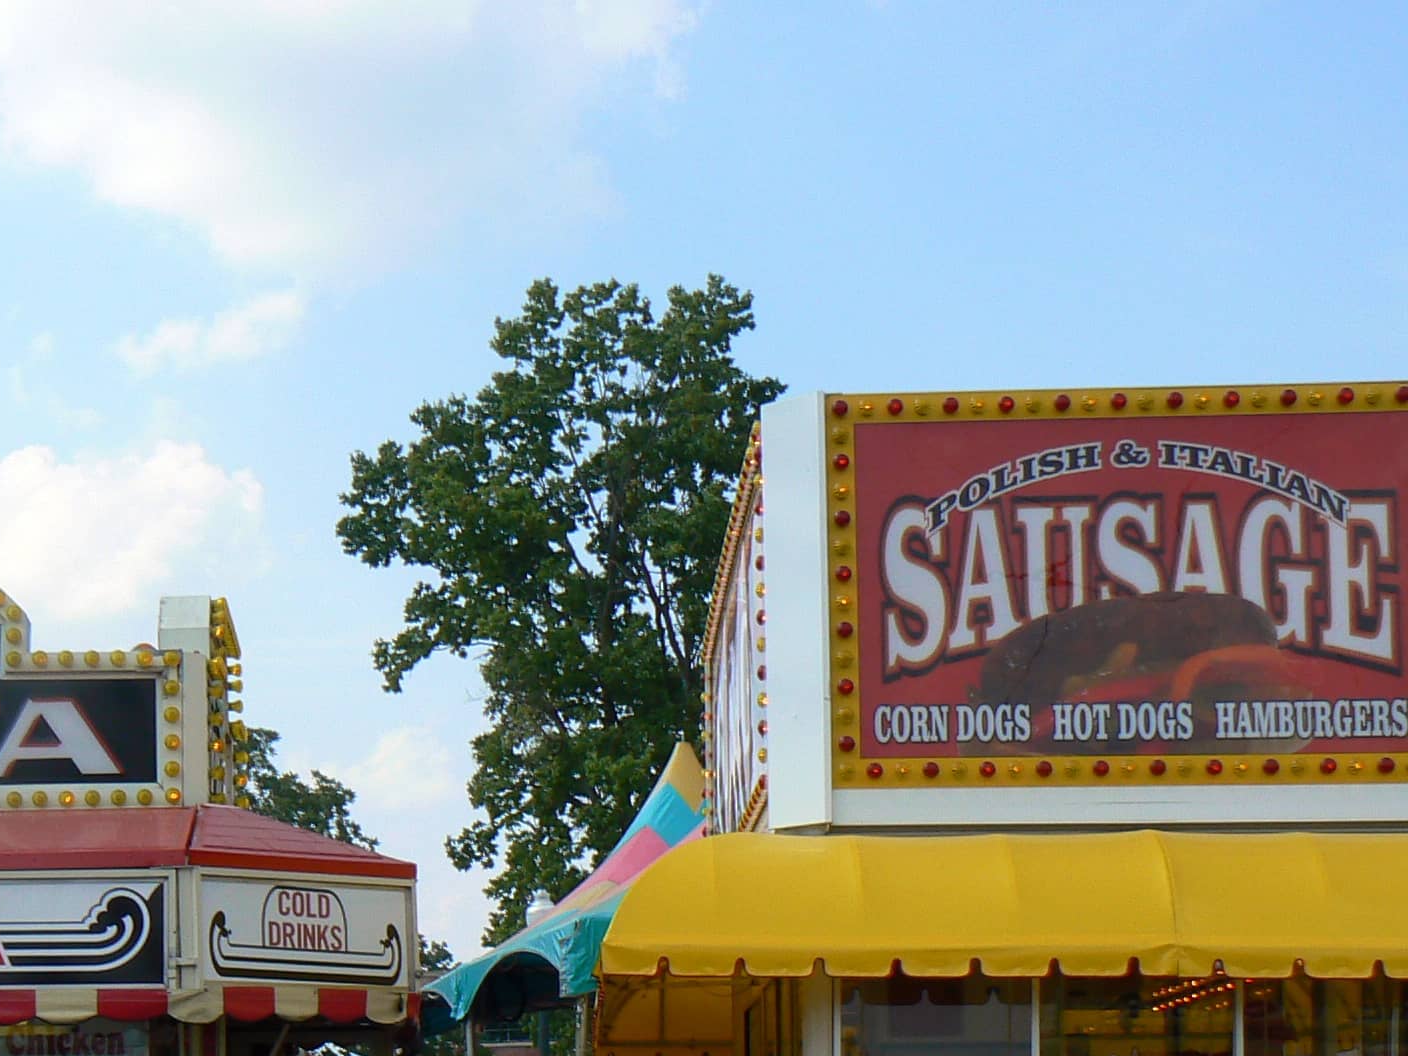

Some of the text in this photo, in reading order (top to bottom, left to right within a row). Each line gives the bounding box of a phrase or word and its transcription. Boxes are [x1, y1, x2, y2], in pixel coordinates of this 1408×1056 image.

[927, 440, 1349, 533] POLISH & ITALIAN
[882, 495, 1395, 672] SAUSAGE
[874, 699, 1408, 743] CORN DOGS HOT DOGS HAMBURGERS
[278, 891, 330, 918] COLD
[269, 921, 343, 951] DRINKS
[6, 1024, 125, 1056] Chicken
